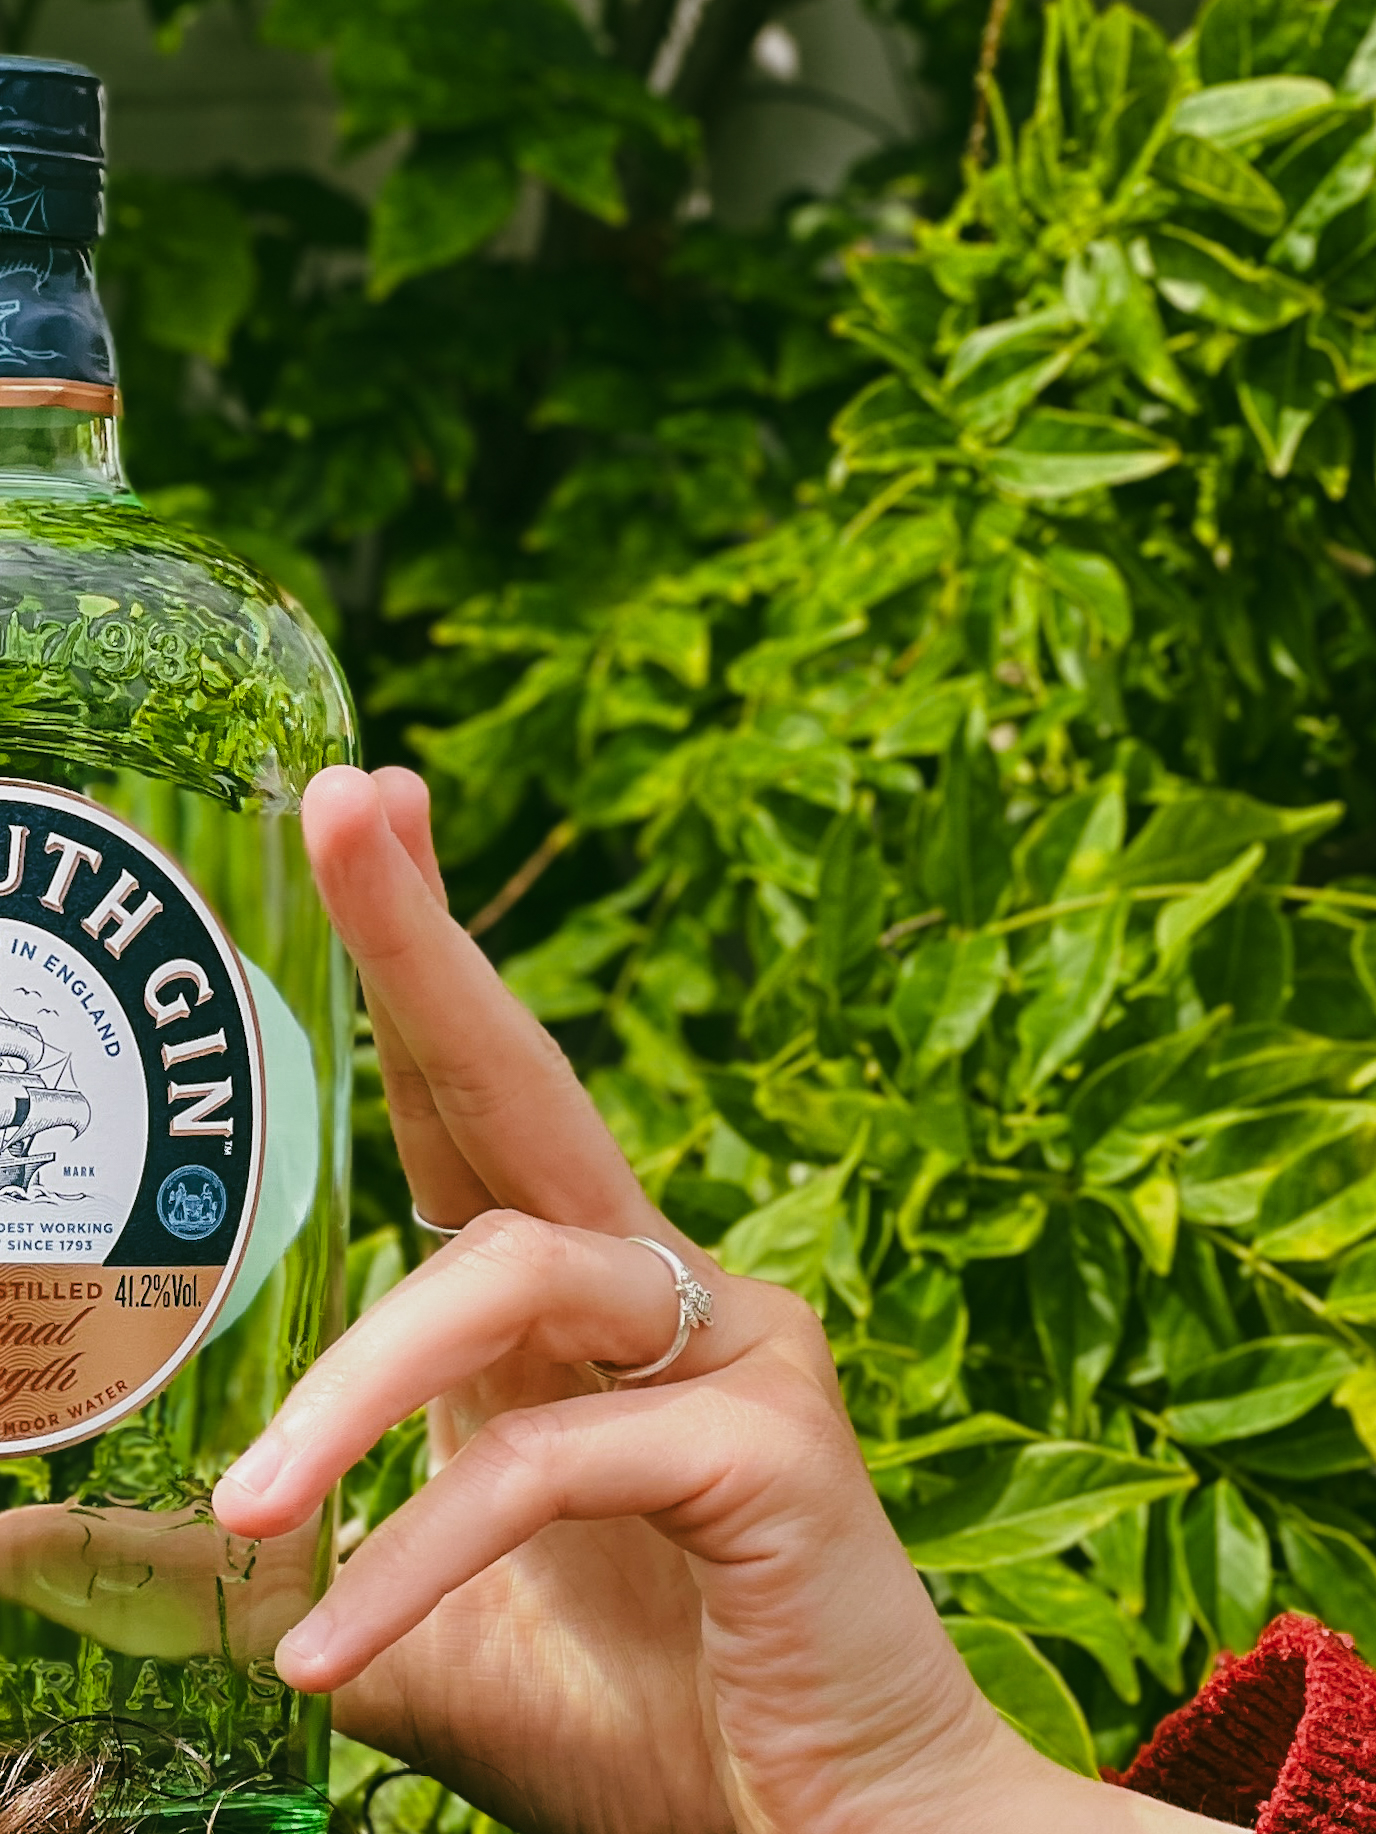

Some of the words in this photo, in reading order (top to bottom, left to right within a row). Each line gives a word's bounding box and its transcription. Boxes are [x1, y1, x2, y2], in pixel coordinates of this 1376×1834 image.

[10, 937, 38, 961] IN
[42, 953, 122, 1058] ENGLAND
[144, 957, 234, 1139] GIN
[62, 1165, 96, 1178] MARK
[40, 1222, 114, 1235] WORKING
[6, 1239, 54, 1252] SINCE
[58, 1240, 93, 1252] 1793
[66, 1379, 129, 1419] WATER
